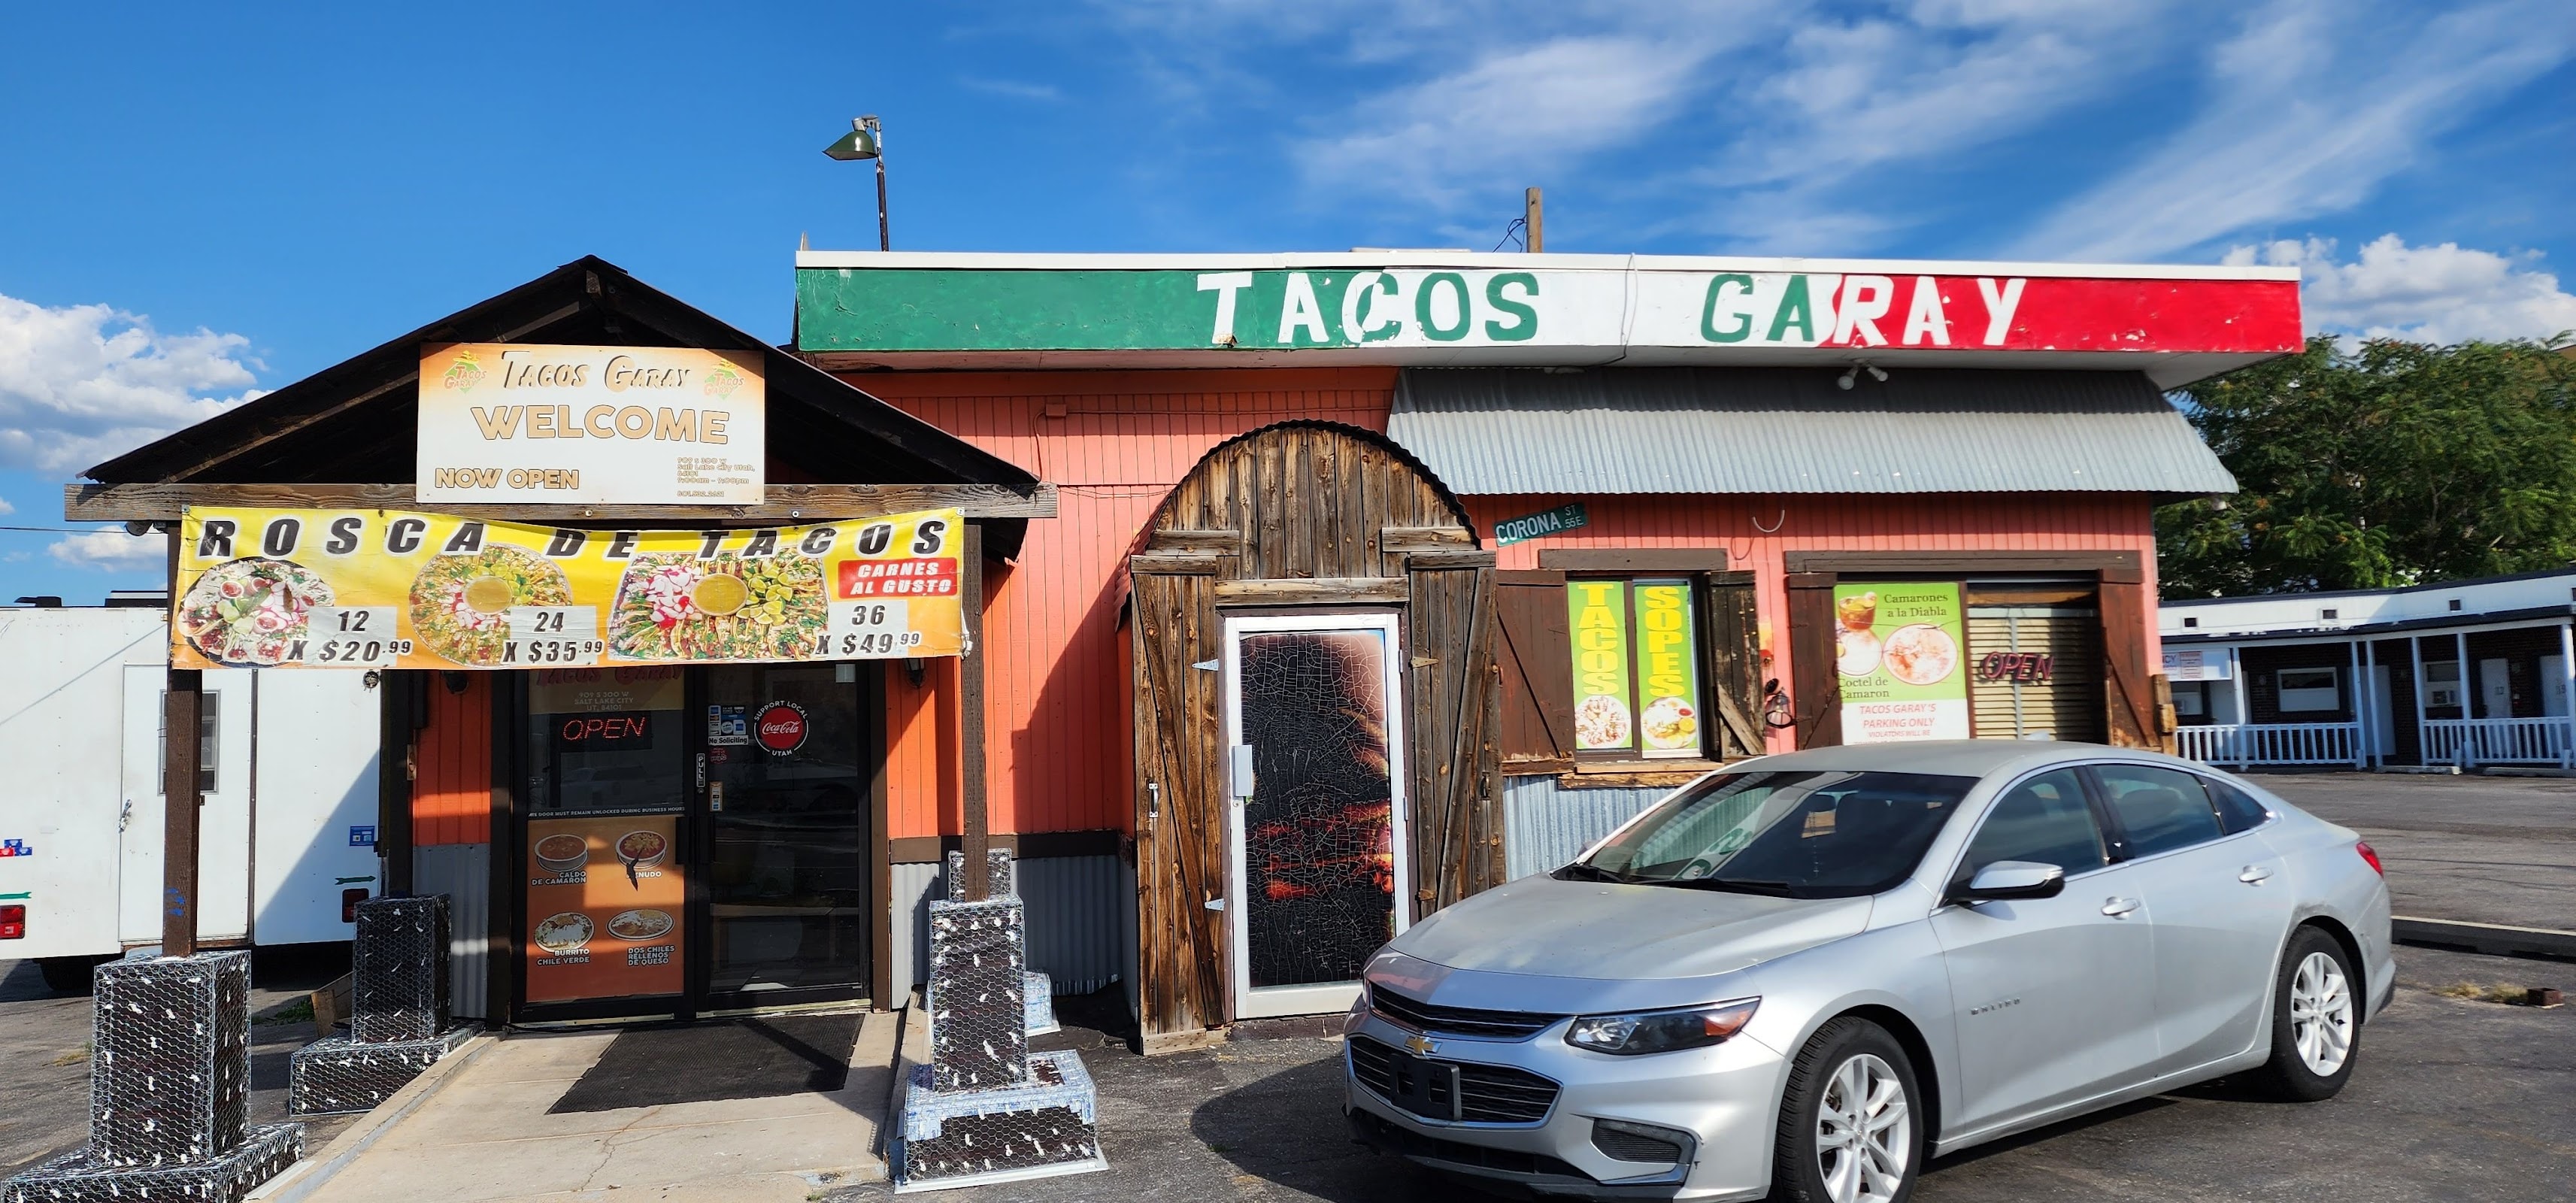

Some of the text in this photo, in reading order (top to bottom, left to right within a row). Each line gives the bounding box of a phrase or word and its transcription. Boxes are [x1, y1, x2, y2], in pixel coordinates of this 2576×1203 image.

[1197, 271, 2027, 347] TACOS GARAY
[455, 366, 486, 378] TACOS
[502, 351, 690, 392] TACOS GARAY
[470, 405, 729, 444] WELCOME
[435, 468, 579, 489] NOW OPEN
[1496, 505, 1576, 543] CORONA ST
[199, 517, 945, 559] ROSCA DE TACOS
[857, 562, 939, 578] CARNES
[850, 579, 951, 595] AL GUSTO
[1884, 594, 1948, 604] Camarones
[338, 610, 368, 632] 12
[535, 611, 564, 633] 24
[851, 605, 885, 626] 36
[1896, 608, 1907, 617] la
[1909, 607, 1947, 617] Diabla
[816, 635, 832, 656] X
[1577, 584, 1620, 695] TACOS
[1644, 586, 1686, 698] SOPES
[286, 639, 411, 663] X $20.99
[503, 639, 604, 664] X $35.99
[1982, 651, 2054, 680] OPEN
[1839, 677, 1889, 687] Coctel de
[1839, 689, 1890, 699] Camaron
[753, 701, 809, 722] SUPPORT LOCAL
[1860, 705, 1891, 714] TACOS
[563, 716, 647, 741] OPEN
[1863, 717, 1935, 728] PARKING ONLY
[554, 948, 589, 956] BURRITO
[641, 958, 669, 966] QUESO
